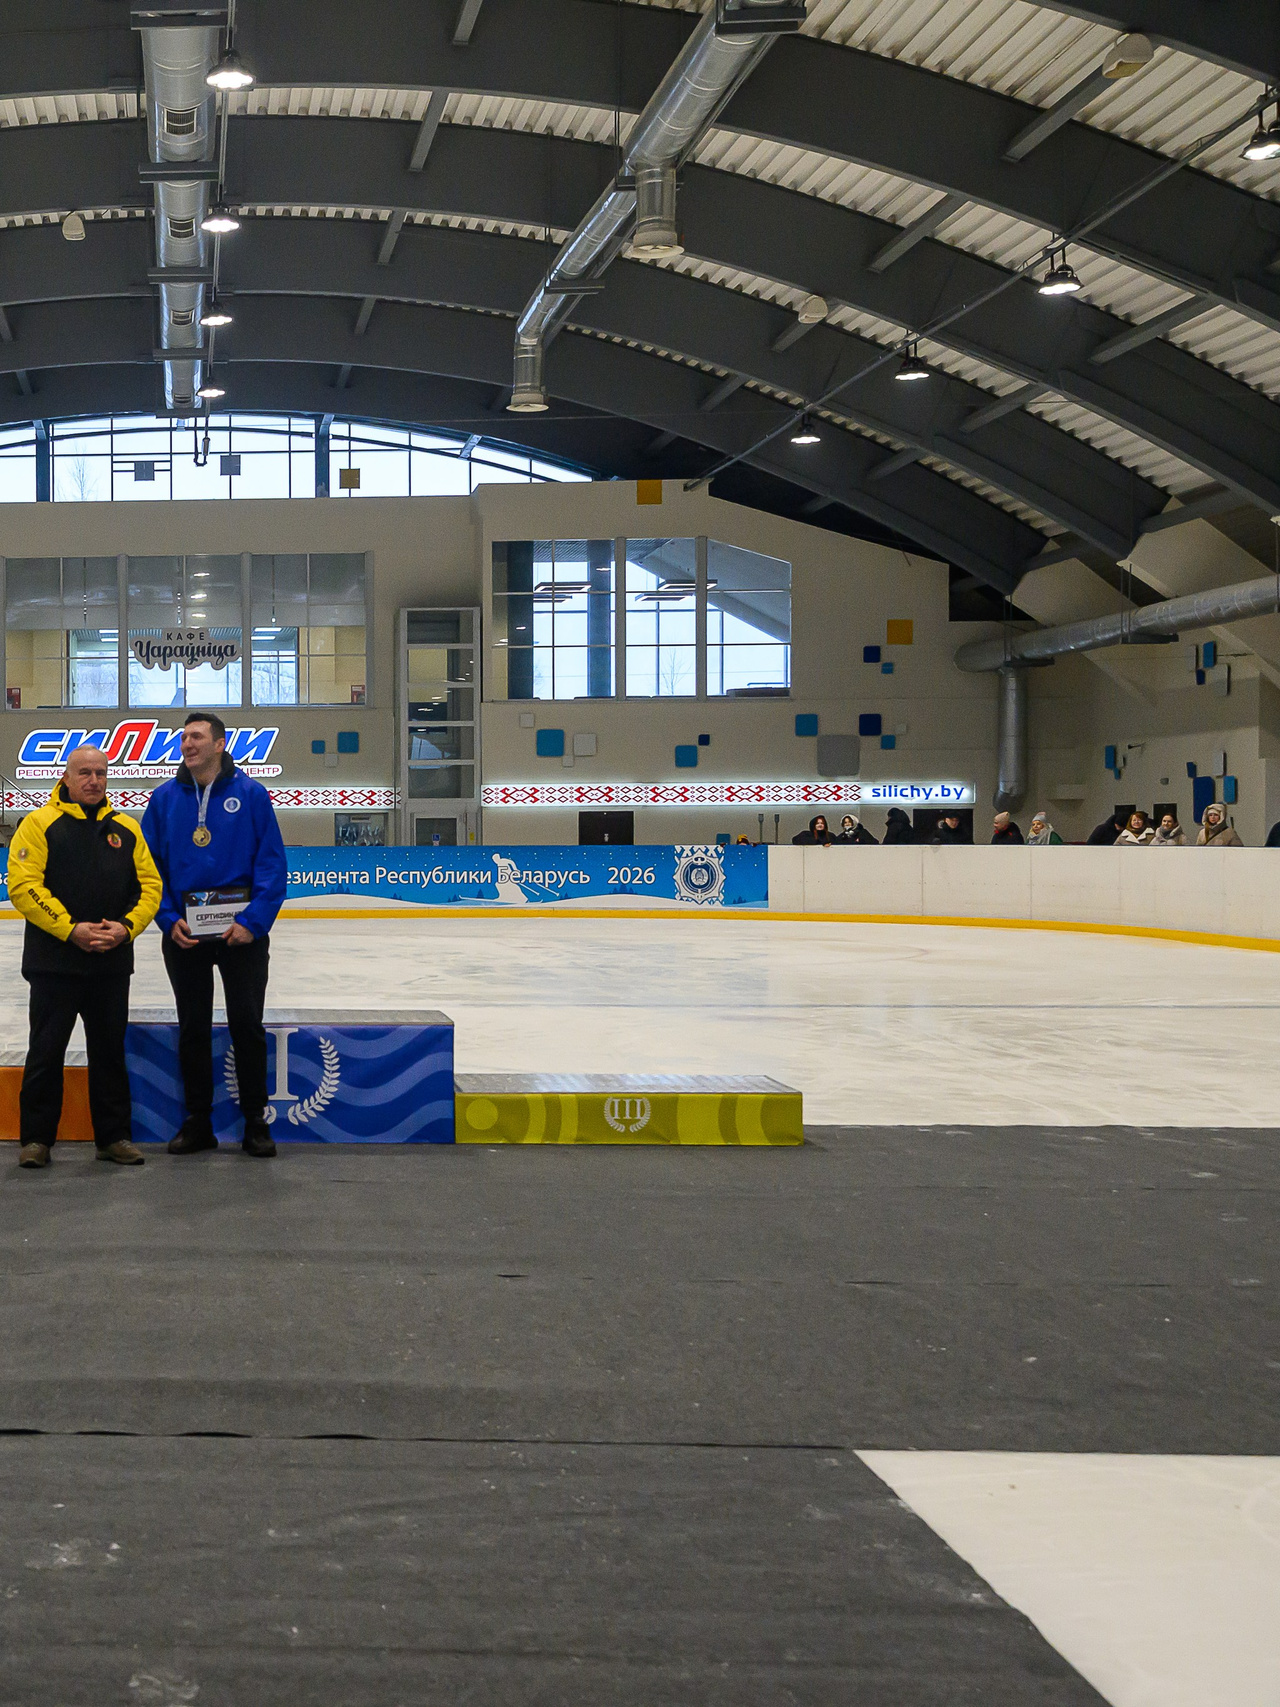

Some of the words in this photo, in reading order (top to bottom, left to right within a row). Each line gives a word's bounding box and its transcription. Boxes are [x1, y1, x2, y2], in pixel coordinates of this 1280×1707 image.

[166, 632, 205, 641] КАФЕ
[20, 720, 278, 763] СИЛИИ
[18, 767, 140, 777] РЕСПУБСКИЙ
[872, 785, 965, 800] silichy.by
[375, 866, 492, 888] Республики
[497, 866, 591, 888] Беларусь
[607, 866, 656, 884] 2026
[27, 888, 60, 921] BELARUS
[612, 1099, 643, 1119] III
